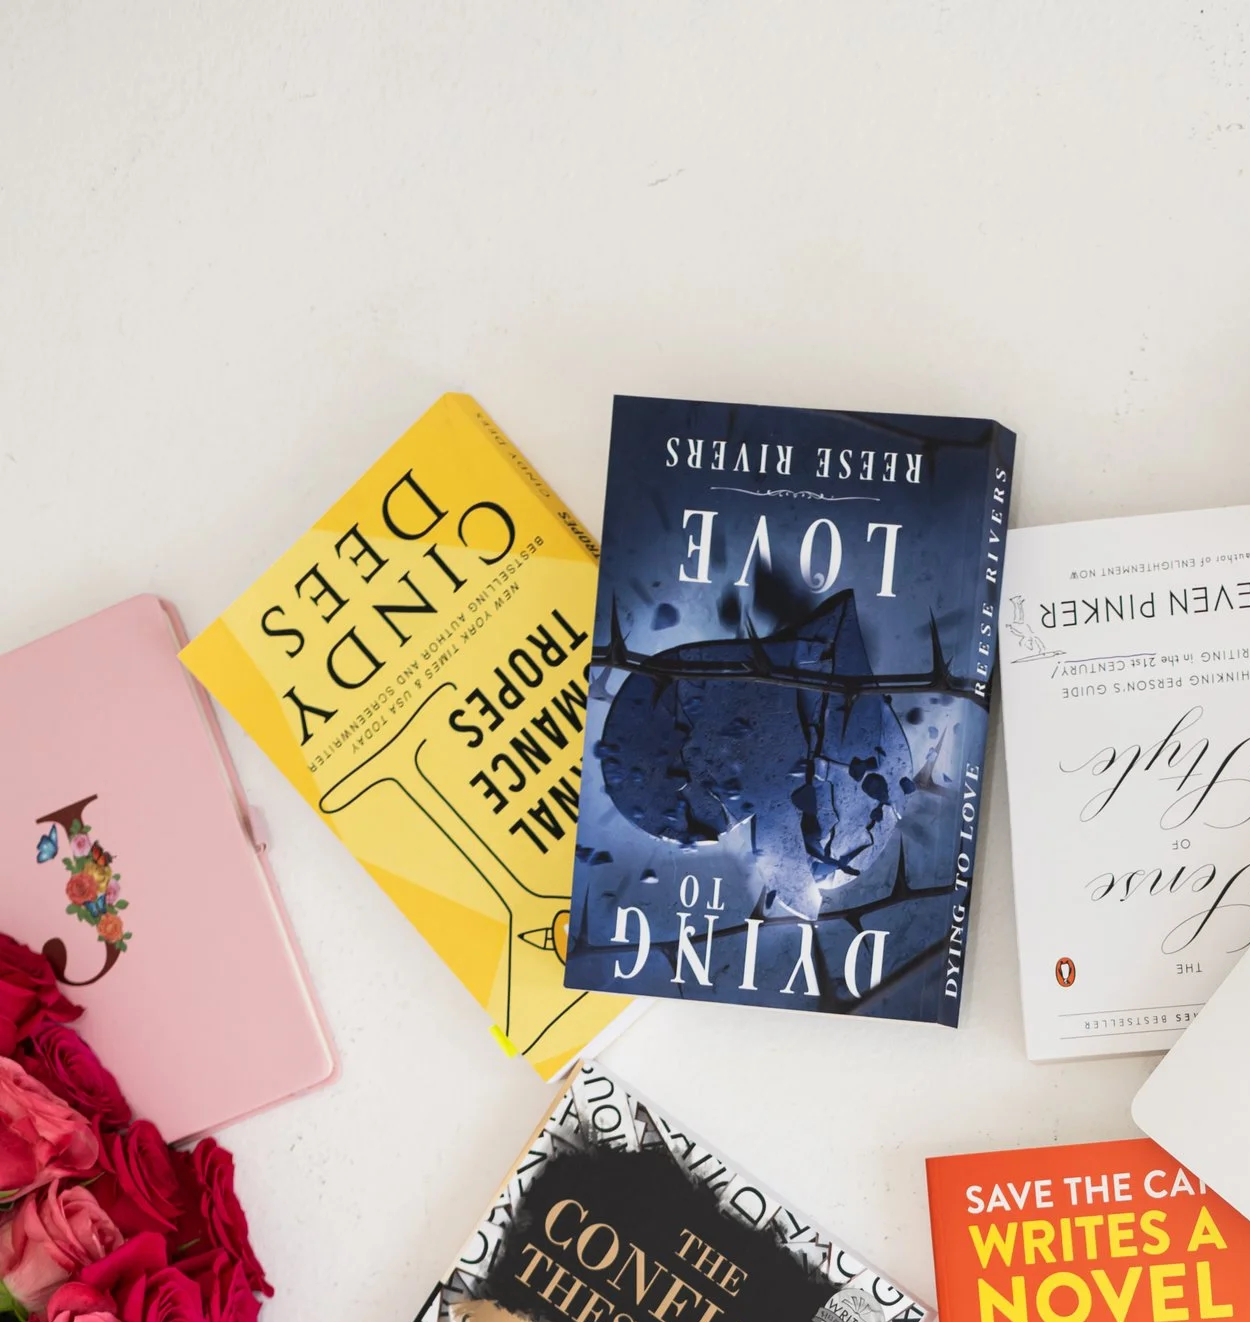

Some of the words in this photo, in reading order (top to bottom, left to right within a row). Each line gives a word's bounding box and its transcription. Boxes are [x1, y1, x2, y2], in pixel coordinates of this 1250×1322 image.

[666, 437, 793, 475] RIVERS
[816, 448, 922, 484] REESE
[261, 468, 449, 659] DEES
[679, 510, 902, 597] LOVE
[1101, 558, 1196, 577] ENLIGHTENMENT
[1200, 556, 1212, 568] of
[1216, 552, 1250, 564] author
[467, 535, 545, 613] BESTSELLING
[974, 603, 993, 700] REESE
[985, 467, 1006, 583] RIVERS
[1070, 569, 1096, 580] NOW
[494, 581, 520, 610] NEW
[1039, 592, 1156, 629] PINKER
[282, 501, 516, 747] CINDY
[421, 612, 466, 661] AUTHOR
[460, 610, 492, 644] YORK
[396, 660, 419, 685] AND
[424, 644, 460, 680] TIMES
[1130, 657, 1156, 668] 21st
[1160, 654, 1180, 667] the
[1183, 653, 1194, 664] in
[414, 678, 422, 689] &
[448, 608, 589, 748] TROPES
[1062, 684, 1107, 699] GUIDE
[1113, 677, 1183, 694] PERSON'S
[389, 690, 412, 715] USA
[303, 685, 395, 775] SCREENWRITER
[351, 715, 388, 754] TODAY
[959, 762, 980, 840] LOVE
[1172, 838, 1191, 851] OF
[954, 852, 970, 891] TO
[679, 874, 725, 910] TO
[612, 901, 888, 998] DYING
[944, 905, 966, 998] DYING
[1176, 962, 1203, 975] THE
[1085, 1014, 1168, 1030] BESTSELLER
[965, 1179, 1054, 1215] SAVE
[1063, 1172, 1133, 1206] THE
[968, 1209, 1171, 1269] WRITES
[1187, 1205, 1228, 1252] A
[675, 1228, 748, 1297] THE
